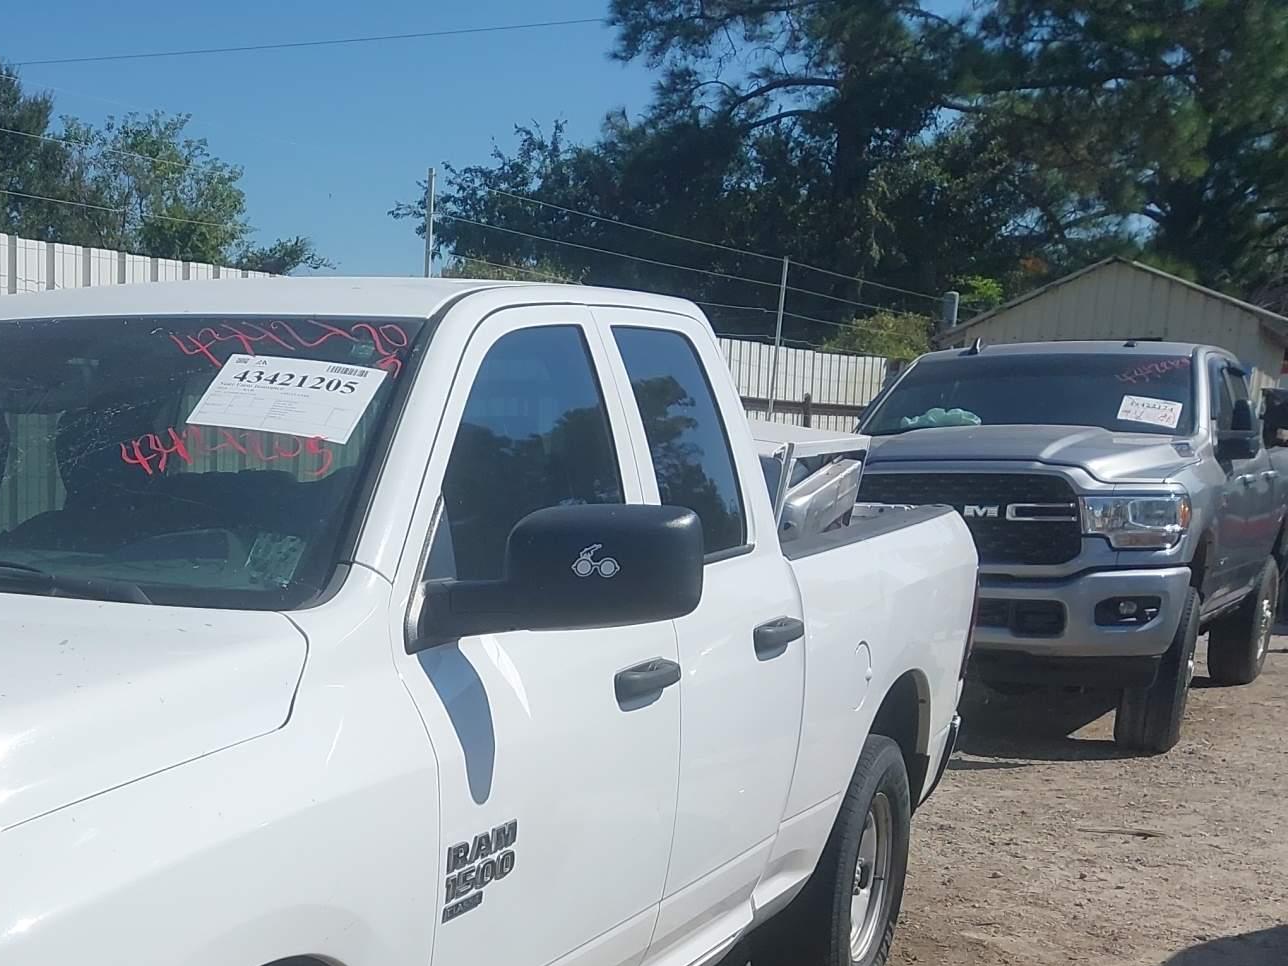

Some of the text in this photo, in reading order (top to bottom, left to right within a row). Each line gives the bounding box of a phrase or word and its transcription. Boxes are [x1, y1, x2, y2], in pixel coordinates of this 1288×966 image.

[233, 369, 361, 395] 43421205
[446, 819, 518, 876] RAM
[445, 849, 516, 905] 1500
